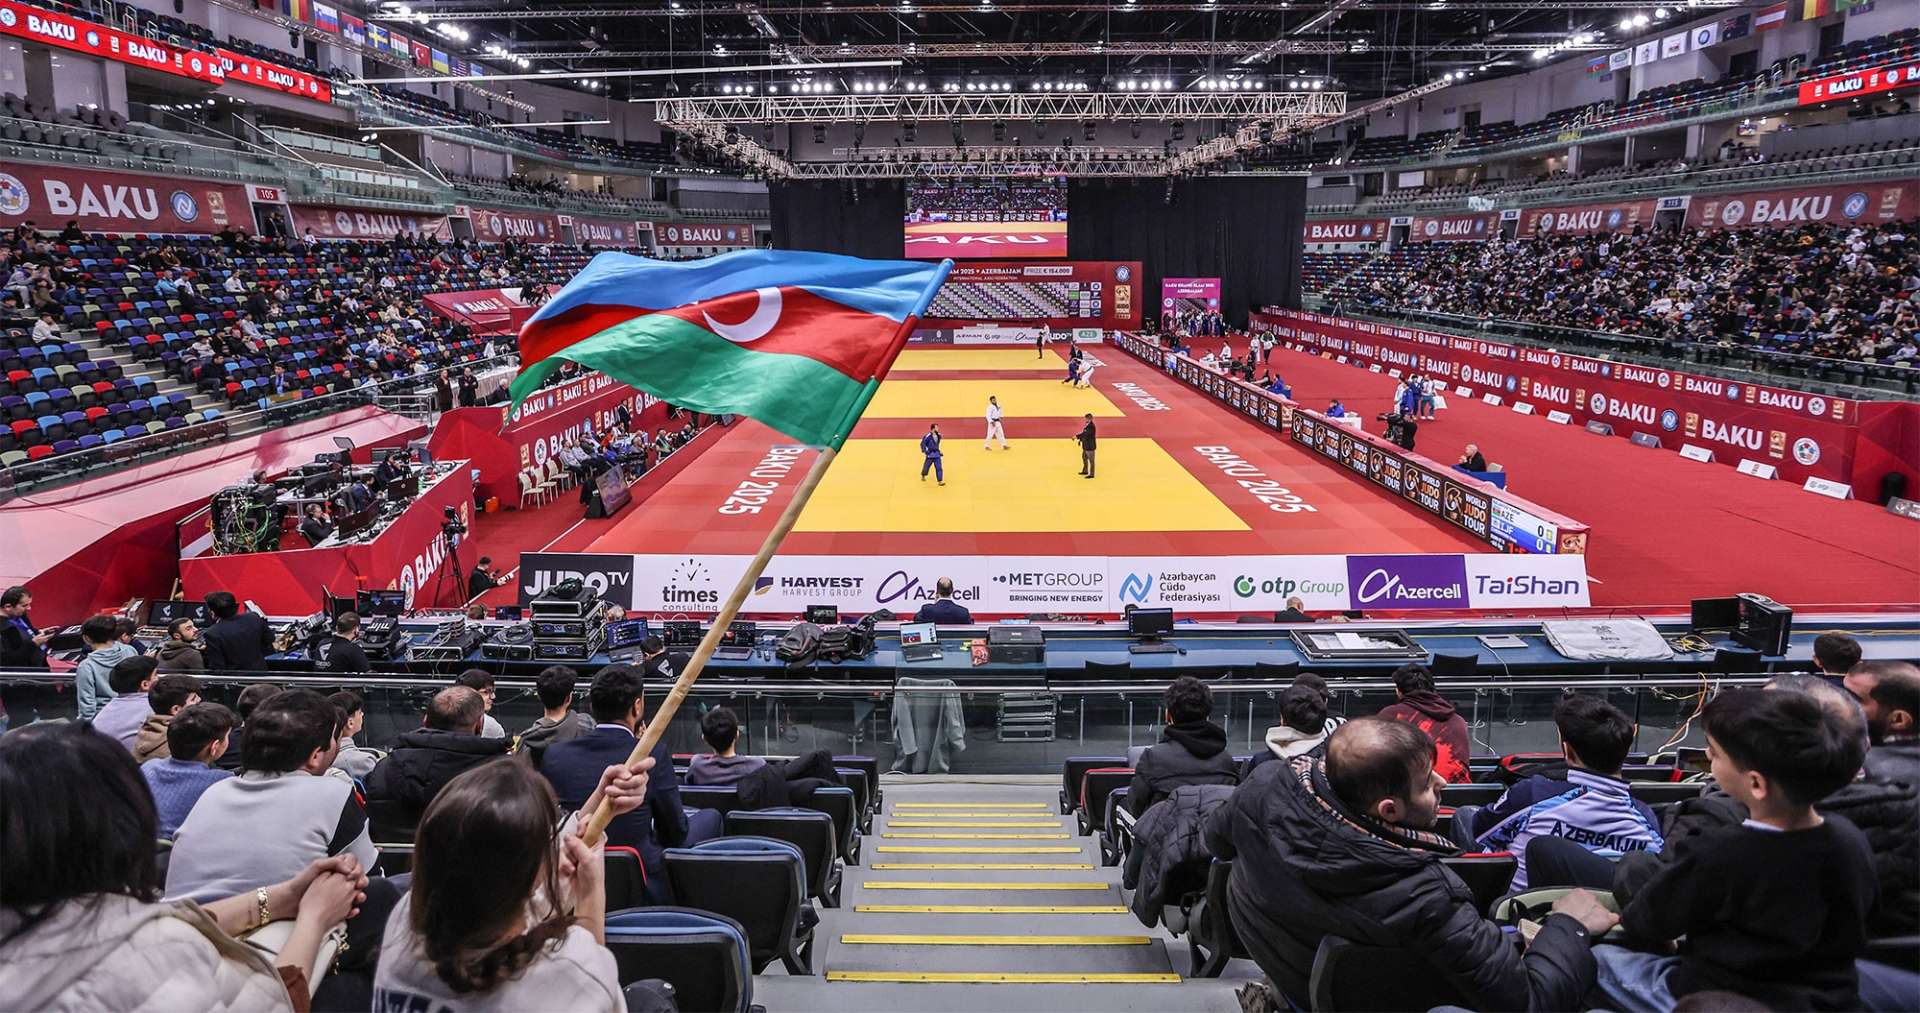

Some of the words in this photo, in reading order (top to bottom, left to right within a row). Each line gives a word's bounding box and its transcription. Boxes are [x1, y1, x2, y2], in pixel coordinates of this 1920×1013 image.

[27, 14, 77, 42] BAKU
[128, 41, 167, 63] BAKU
[267, 70, 294, 87] BAKU
[1828, 78, 1862, 94] BAKU
[43, 179, 159, 220] BAKU
[260, 189, 274, 199] 105
[1751, 195, 1833, 223] BAKU
[355, 213, 402, 234] BAKU
[504, 218, 535, 237] BAKU
[1442, 219, 1473, 235] BAKU
[1556, 211, 1603, 231] BAKU
[590, 225, 611, 241] BAKU
[682, 228, 722, 241] BAKU
[1311, 224, 1356, 238] BAKU
[905, 235, 1049, 244] AKU
[464, 299, 498, 313] BAKU
[1399, 329, 1412, 339] BAKU
[1425, 334, 1440, 344] BAKU
[1327, 336, 1343, 349] BAKU
[1355, 343, 1374, 357] BAKU
[1454, 339, 1472, 351] BAKU
[1388, 350, 1409, 365] BAKU
[1488, 345, 1508, 357] BAKU
[1526, 351, 1550, 365] BAKU
[1426, 358, 1451, 376] BAKU
[1571, 360, 1598, 373] BAKU
[596, 374, 612, 385] BAKU
[1473, 369, 1503, 388] BAKU
[1624, 368, 1655, 383] BAKU
[563, 384, 582, 401] BAKU
[1533, 382, 1570, 404] BAKU
[1685, 378, 1722, 396] BAKU
[523, 397, 545, 416] BAKU
[644, 393, 661, 408] BA
[1759, 391, 1804, 411] BAKU
[603, 405, 622, 428] BAK
[1609, 398, 1656, 425] BAKU
[1326, 429, 1339, 440] WORLD
[1701, 418, 1763, 450] BAKU
[1326, 437, 1339, 449] JUDO
[1353, 441, 1368, 453] WORLD
[1325, 445, 1338, 459] TOUR
[1353, 450, 1367, 463] JUDO
[749, 446, 805, 478] BAKU
[1352, 459, 1367, 473] TOUR
[1385, 456, 1401, 469] WORLD
[1193, 445, 1266, 477] BAKU
[1237, 479, 1318, 513] 2025
[1384, 465, 1401, 480] JUDO
[1421, 473, 1440, 487] WORLD
[1383, 475, 1400, 492] TOUR
[1421, 482, 1440, 499] JUDO
[718, 481, 779, 514] 2025
[1420, 493, 1439, 511] TOUR
[1465, 493, 1487, 510] WORLD
[1463, 503, 1486, 523] JUDO
[1501, 511, 1514, 523] AZE
[1463, 514, 1485, 536] TOUR
[1537, 525, 1544, 537] 0
[1536, 539, 1543, 551] 0
[781, 577, 864, 588] HARVEST
[1009, 573, 1103, 587] METGROUP
[1159, 571, 1216, 584] Azərbaycan
[1475, 575, 1580, 595] TaiShan
[662, 585, 719, 602] times
[782, 588, 827, 597] HARVEST
[829, 588, 863, 597] GROUP
[913, 585, 980, 601] Azcell
[1159, 582, 1185, 591] Cüdo
[1261, 576, 1296, 598] otp
[1300, 579, 1344, 596] Group
[1395, 583, 1462, 599] Azercell
[1009, 594, 1047, 603] BRINGING
[1049, 594, 1068, 603] NEW
[1070, 594, 1103, 603] ENERGY
[1159, 592, 1221, 603] Federasiyası
[662, 603, 718, 612] consulting
[1550, 820, 1648, 851] AZERBAIJAN
